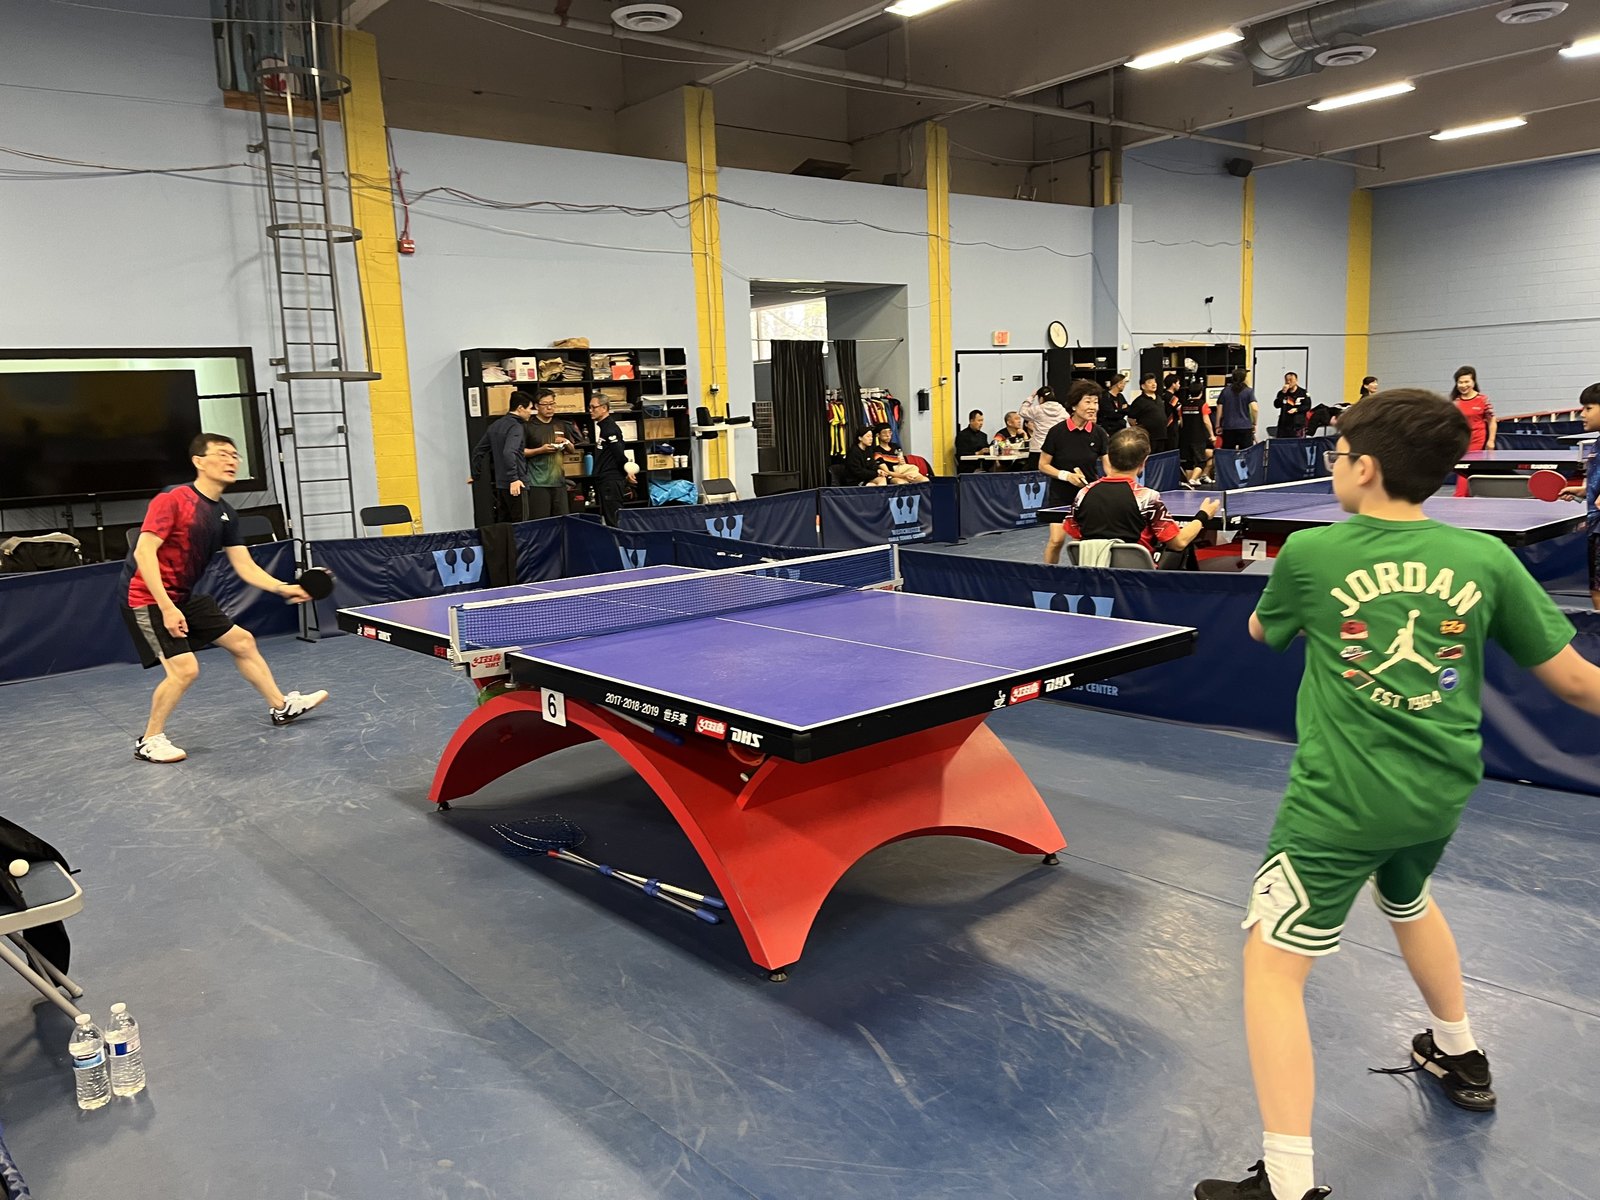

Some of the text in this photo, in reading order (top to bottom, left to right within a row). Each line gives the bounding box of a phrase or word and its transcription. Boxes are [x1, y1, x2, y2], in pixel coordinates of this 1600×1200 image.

[1249, 543, 1259, 556] 7
[1330, 561, 1483, 617] JORDAN
[1043, 672, 1075, 693] DHS
[1085, 682, 1119, 697] CENTER
[547, 693, 557, 719] 6
[604, 692, 660, 717] 2017-2018-2019
[1370, 687, 1404, 709] EST
[730, 726, 764, 749] DHS
